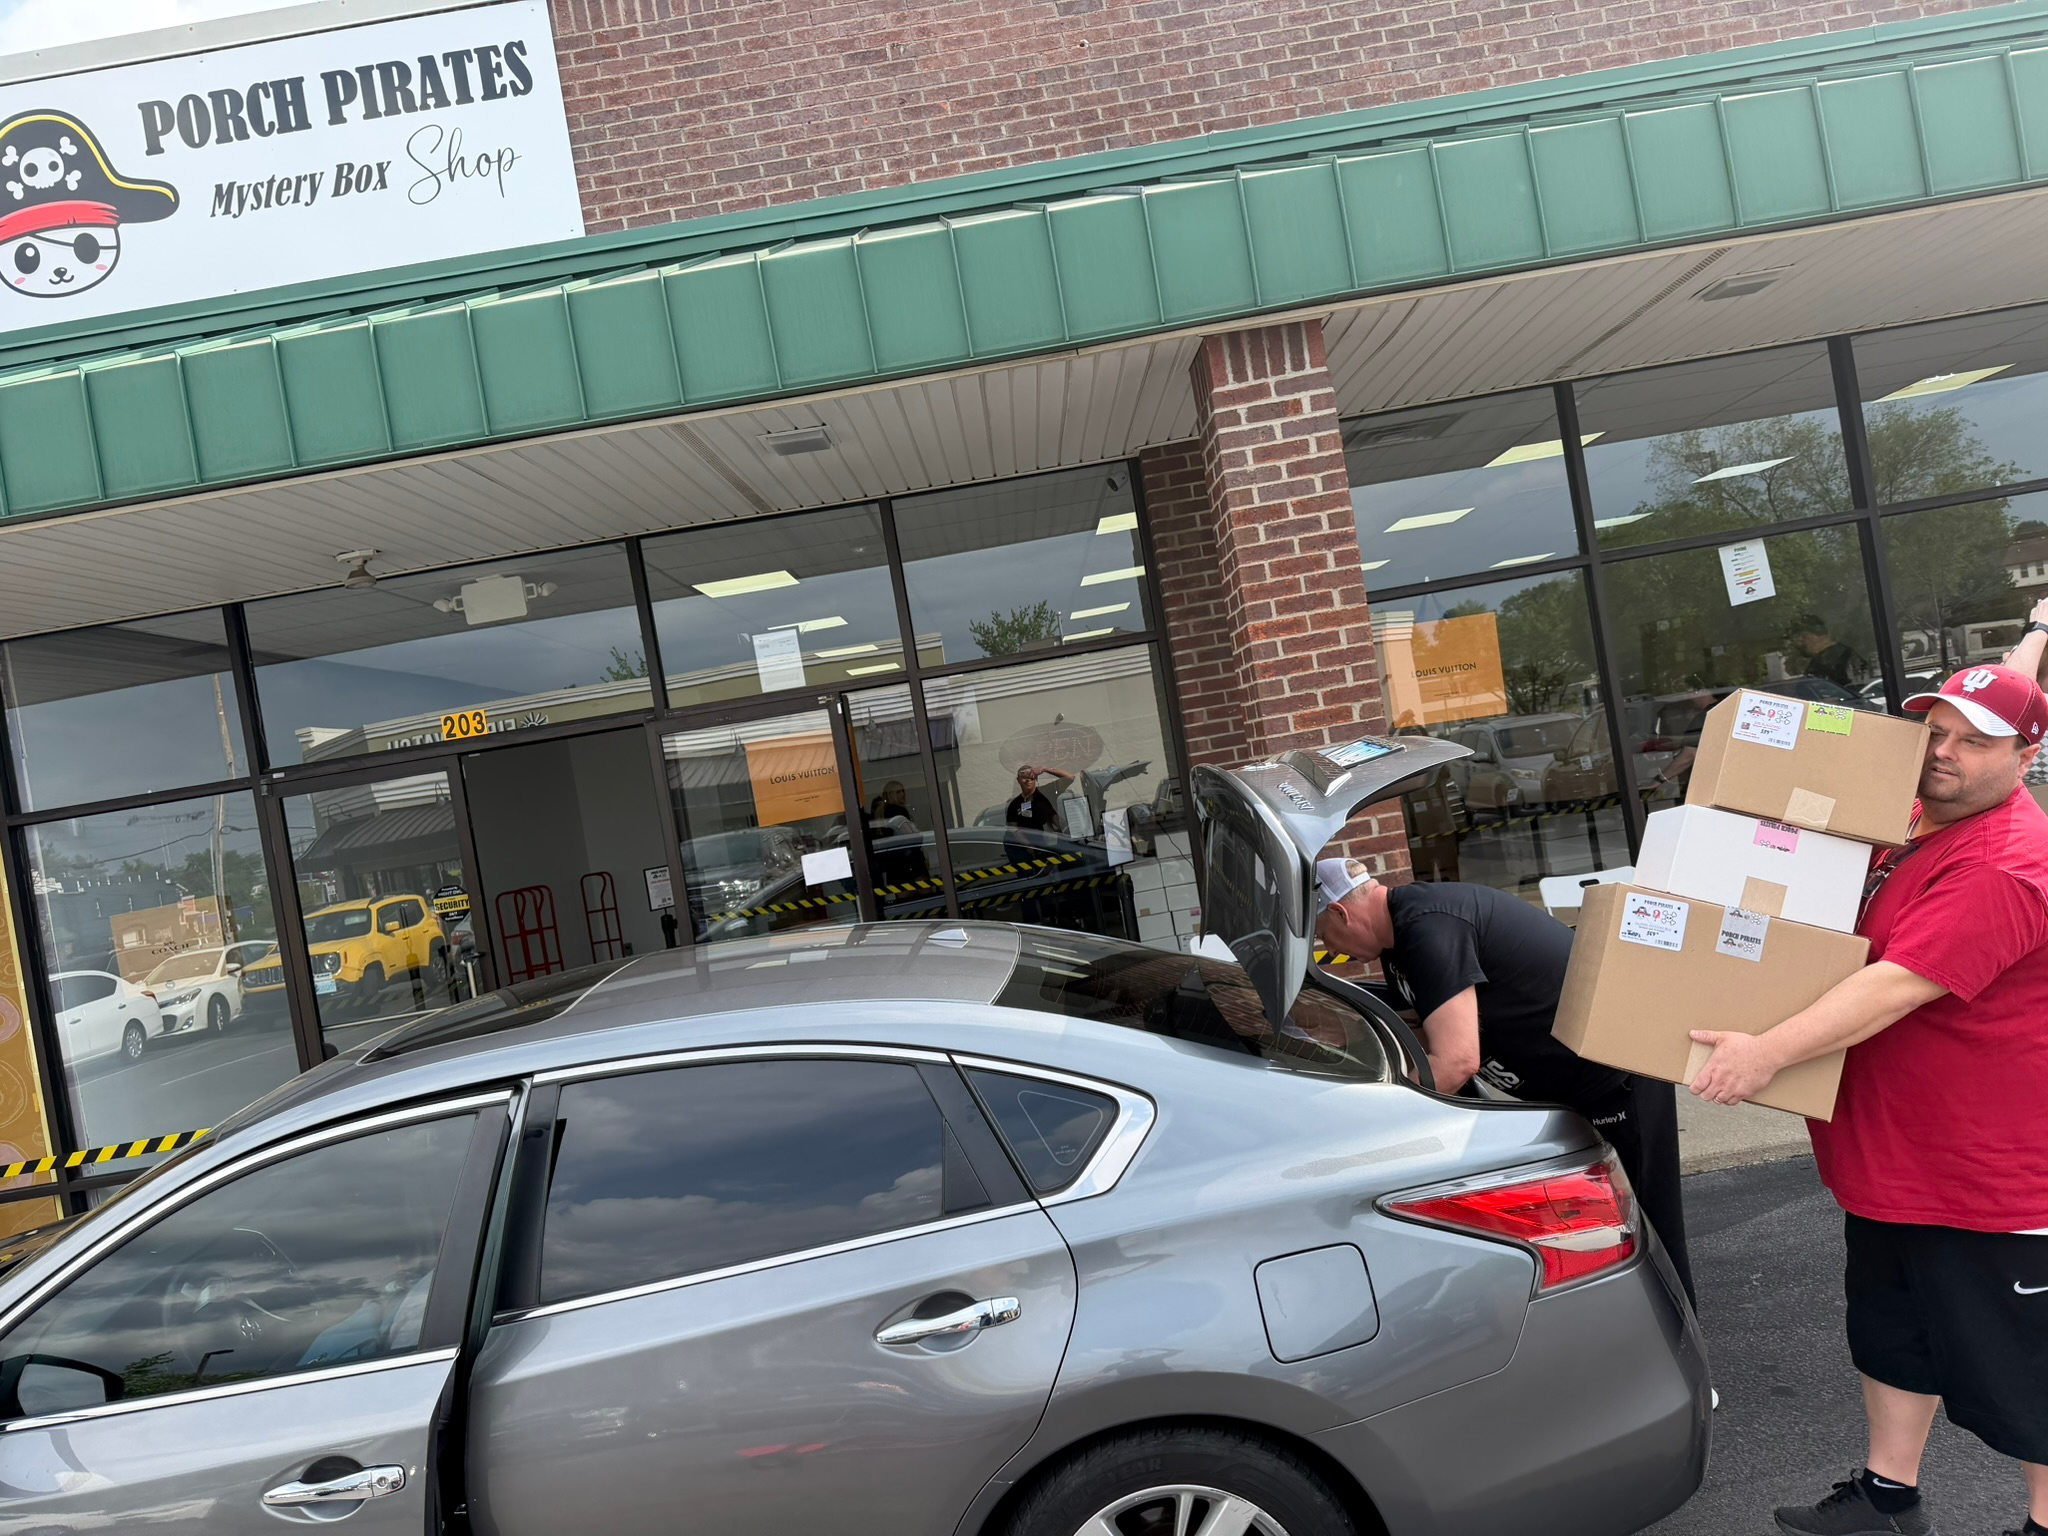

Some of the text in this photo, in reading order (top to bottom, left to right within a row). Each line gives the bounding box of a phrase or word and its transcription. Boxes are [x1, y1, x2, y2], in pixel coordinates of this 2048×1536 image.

[138, 40, 534, 156] PORCH PIRATES
[210, 124, 523, 219] Mystery Box Shop
[1411, 662, 1477, 678] LOUIS VUITTON
[443, 712, 485, 739] 203
[1018, 734, 1092, 763] PEN
[769, 765, 835, 785] LOUIS VUITTON
[434, 899, 469, 911] SECURITY
[1721, 930, 1761, 945] PORCH PIRATES
[1592, 1115, 1618, 1127] Hurley
